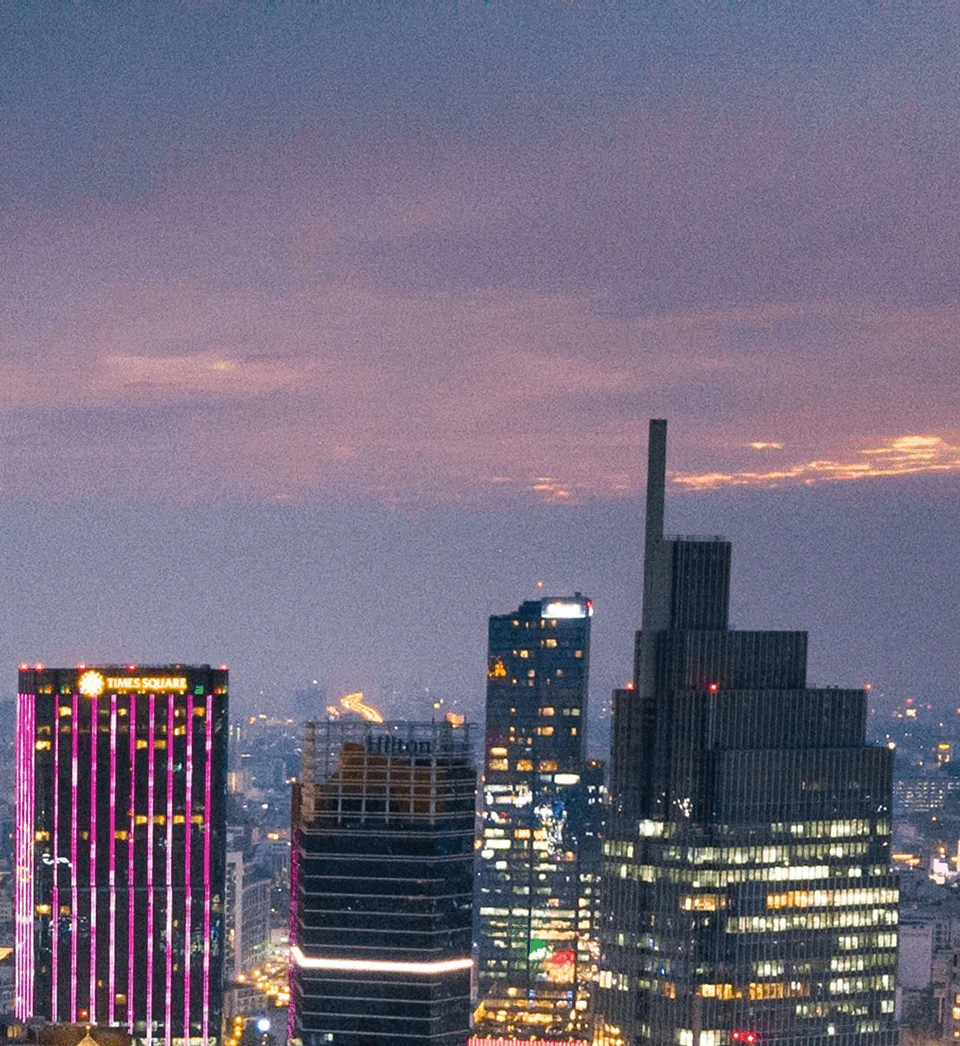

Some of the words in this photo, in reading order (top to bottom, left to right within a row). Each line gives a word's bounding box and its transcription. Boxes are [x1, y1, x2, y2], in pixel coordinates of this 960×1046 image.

[106, 677, 141, 689] TIMES
[142, 677, 187, 690] SQUARE
[368, 735, 430, 754] Hilton
